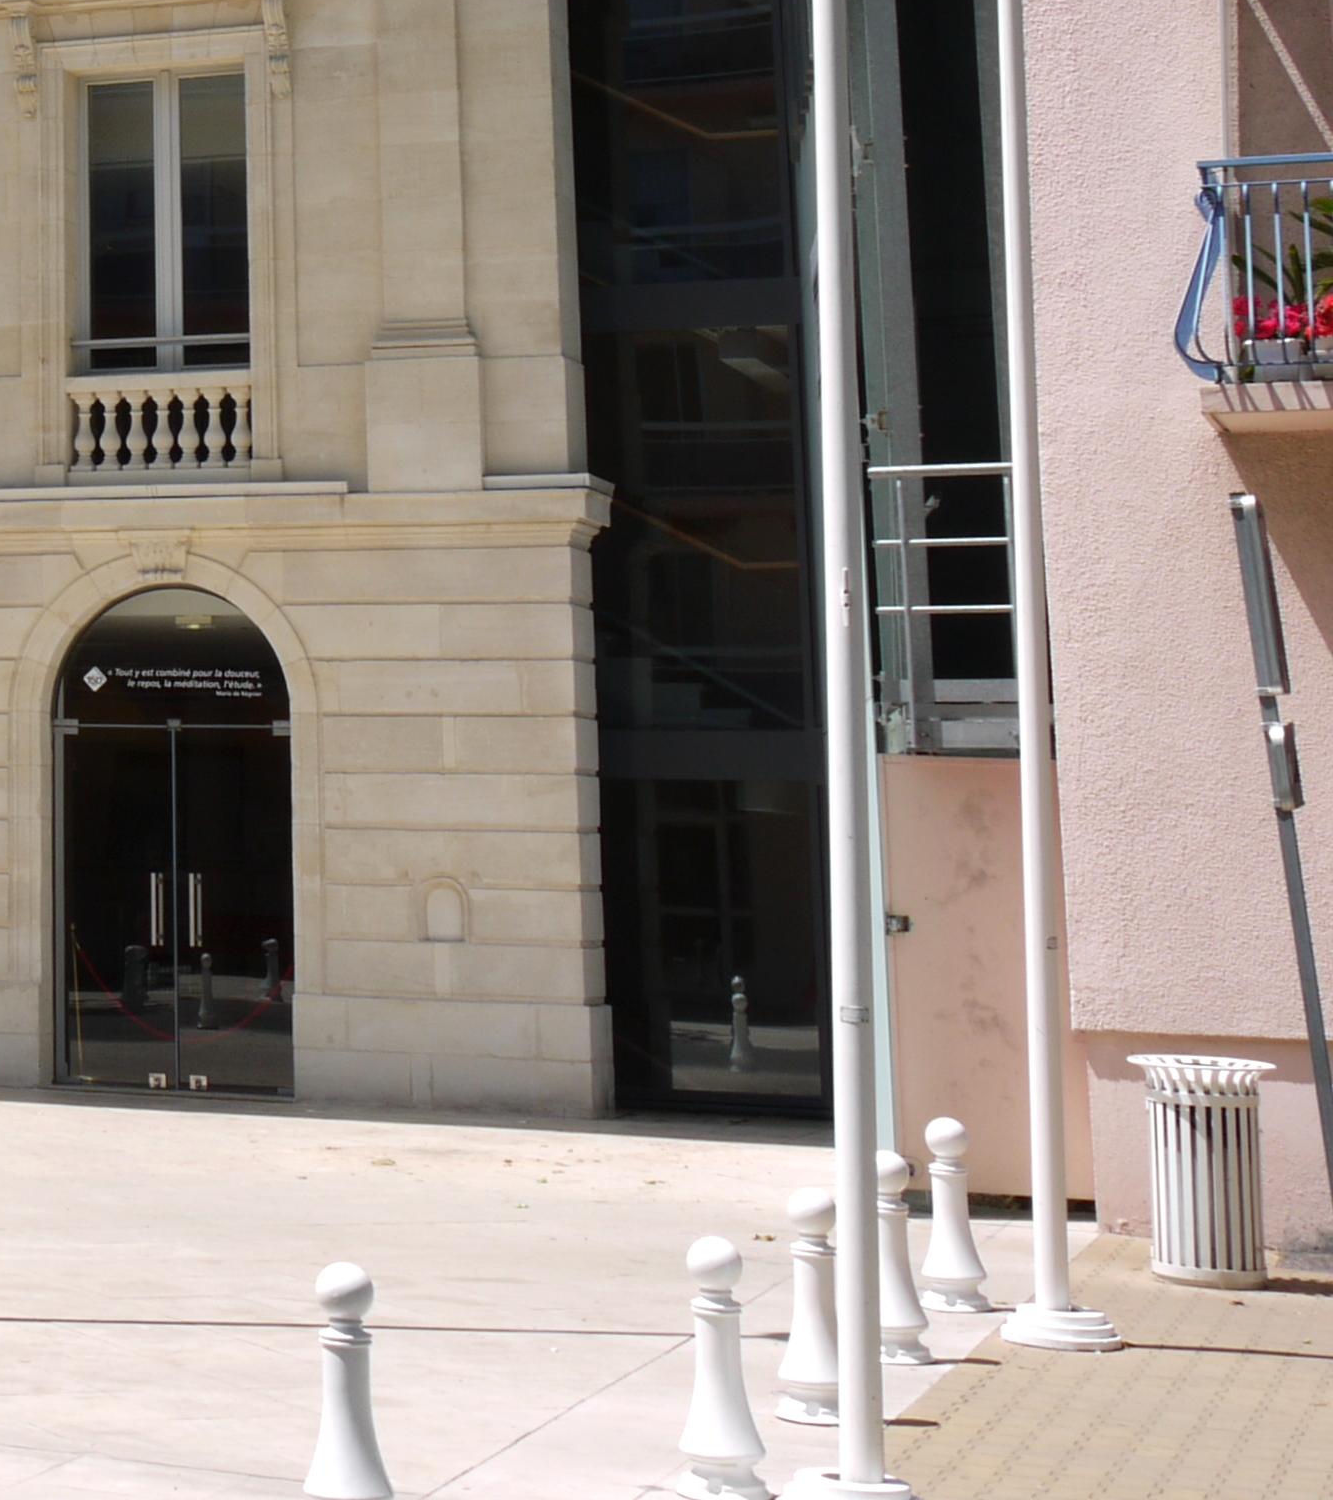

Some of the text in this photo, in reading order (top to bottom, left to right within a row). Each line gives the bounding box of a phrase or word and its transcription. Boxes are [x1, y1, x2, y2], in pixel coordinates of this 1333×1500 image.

[115, 668, 134, 677] Tout
[141, 668, 154, 677] est
[155, 667, 191, 677] combiné
[192, 670, 213, 679] pour
[214, 668, 223, 677] la
